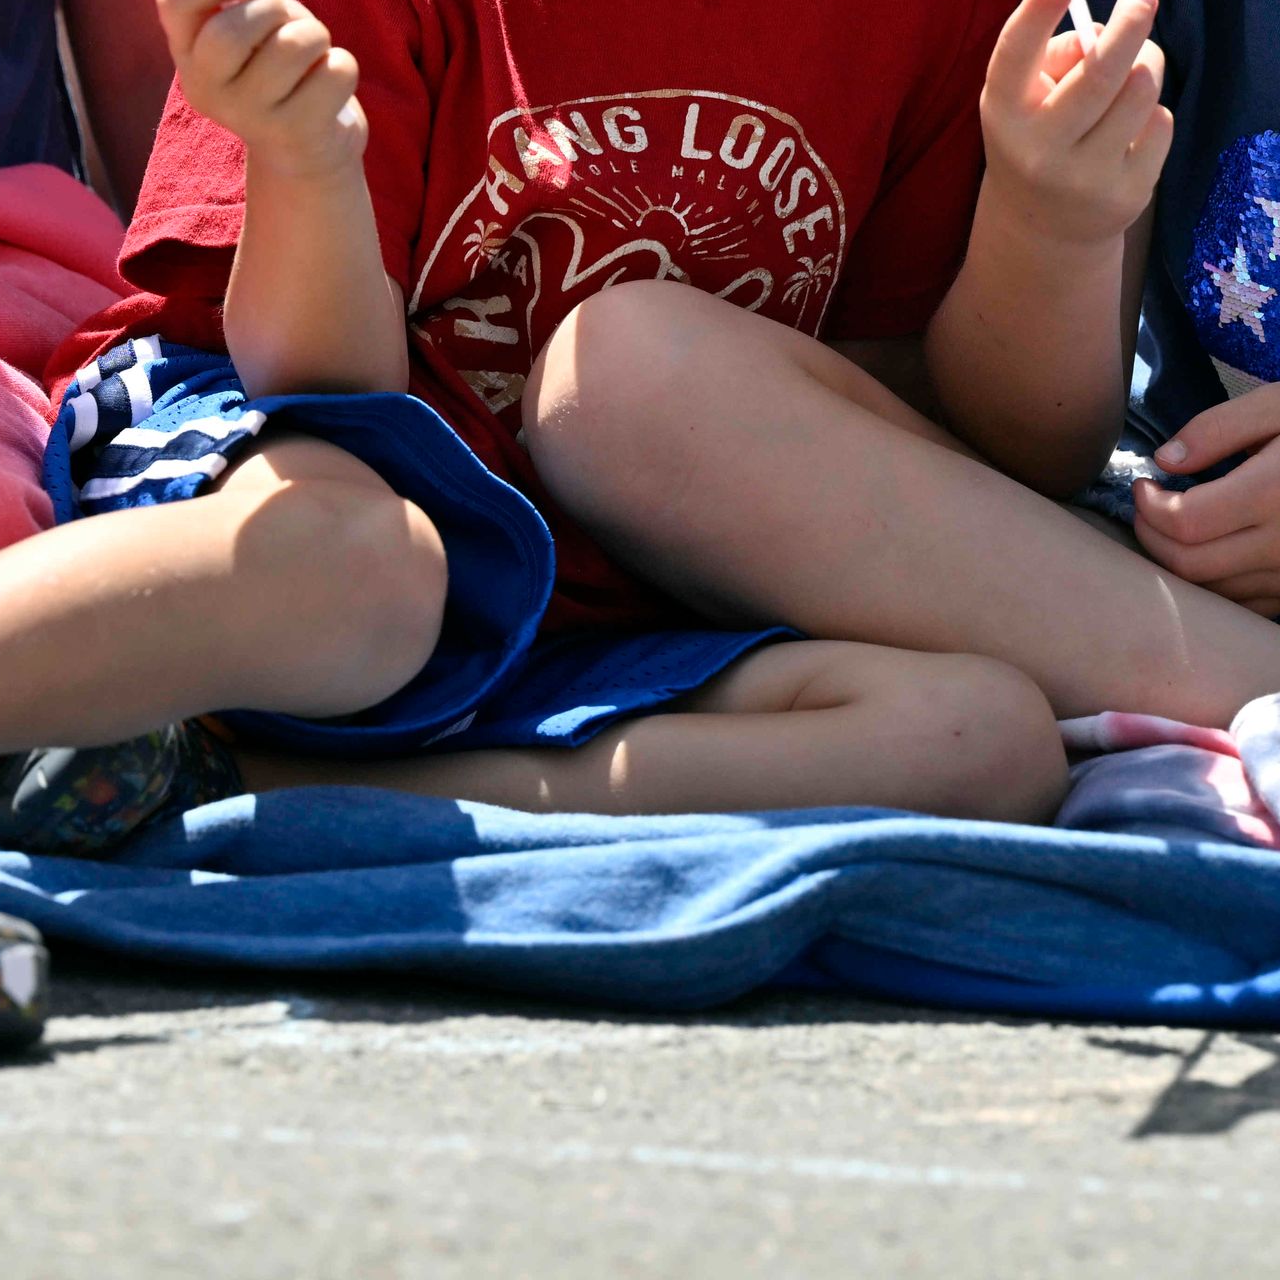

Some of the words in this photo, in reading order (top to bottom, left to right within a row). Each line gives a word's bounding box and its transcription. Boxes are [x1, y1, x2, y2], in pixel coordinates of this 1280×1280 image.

[486, 106, 649, 216] HANG
[681, 103, 833, 254] LOOSE
[671, 164, 764, 227] MALUNA
